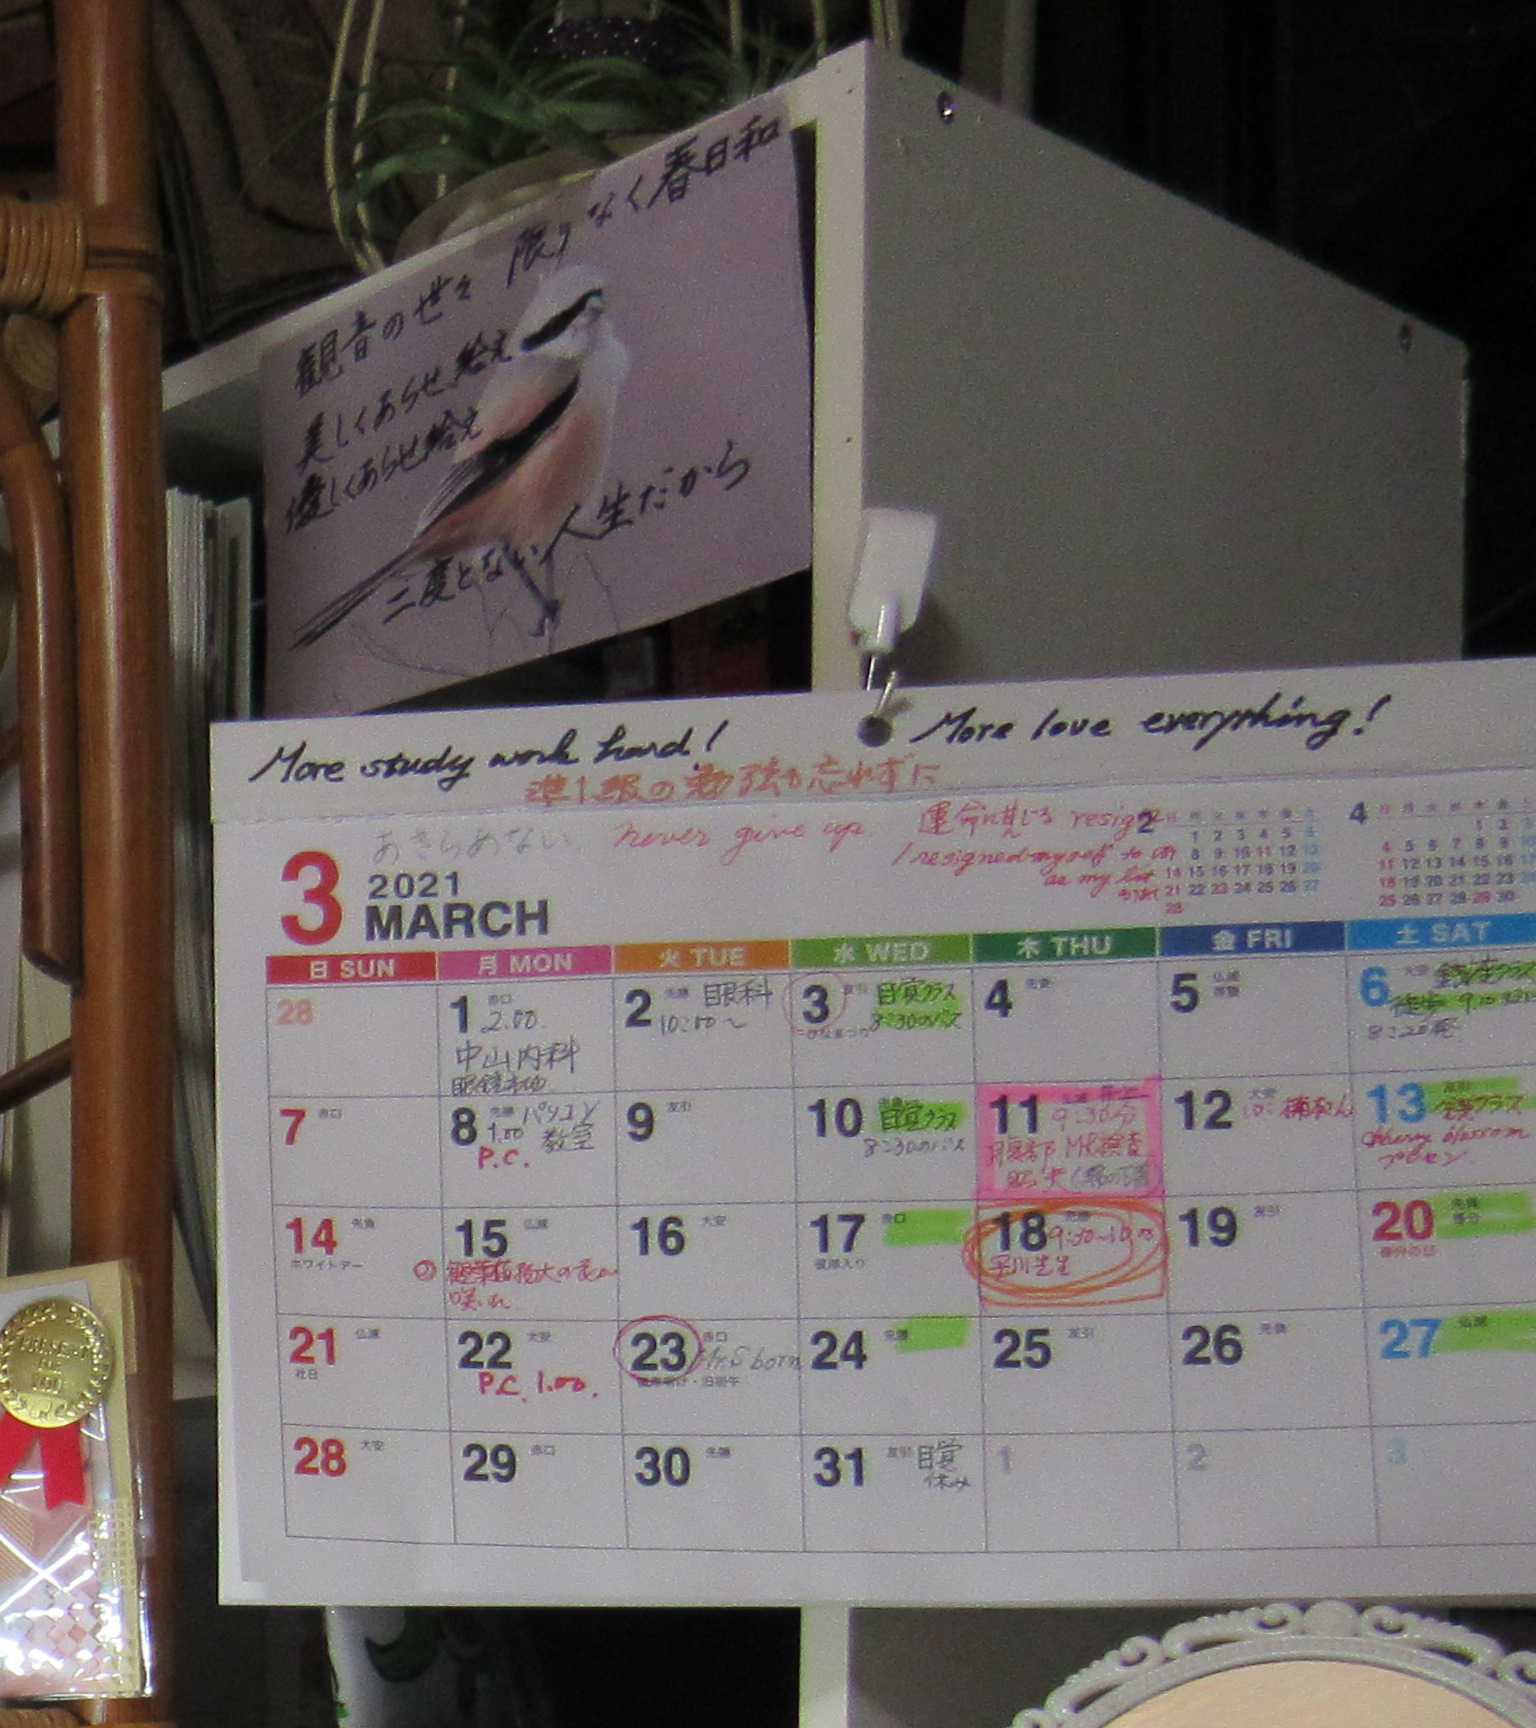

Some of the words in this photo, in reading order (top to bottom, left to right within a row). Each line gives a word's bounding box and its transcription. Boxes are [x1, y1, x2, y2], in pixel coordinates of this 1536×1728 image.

[908, 706, 1015, 745] More
[1029, 708, 1113, 742] love
[248, 740, 346, 784] More
[359, 745, 475, 792] study
[489, 727, 578, 767] work
[1349, 800, 1368, 825] 4
[280, 850, 344, 946] 3
[367, 871, 463, 900] 2021
[364, 899, 551, 943] MARCH
[1245, 927, 1295, 950] FRI
[1430, 920, 1493, 943] SAT
[478, 954, 498, 977] 月
[509, 952, 575, 974] MON
[691, 946, 746, 967] TUE
[868, 942, 930, 964] WED
[1052, 935, 1113, 958] THU
[339, 958, 397, 979] SUN
[1359, 965, 1391, 1009] 6
[625, 988, 653, 1029] 2
[702, 976, 774, 1009] 眼科
[801, 983, 831, 1025] 3
[984, 978, 1014, 1019] 4
[1169, 972, 1201, 1015] 5
[449, 995, 470, 1034] 1
[454, 1033, 582, 1074] 中山内科
[627, 1101, 656, 1143] 9
[807, 1097, 865, 1139] 10
[989, 1093, 1040, 1136] 11
[1173, 1088, 1233, 1131] 12
[1366, 1081, 1426, 1125] 13
[279, 1107, 308, 1147] 7
[449, 1106, 478, 1147] 8
[285, 1215, 338, 1257] 14
[454, 1217, 509, 1259] 15
[630, 1215, 686, 1257] 16
[809, 1213, 866, 1255] 17
[991, 1210, 1049, 1253] 18
[1178, 1205, 1239, 1249] 19
[1370, 1199, 1436, 1243] 20
[288, 1325, 337, 1367] 21
[457, 1330, 513, 1371] 22
[630, 1332, 688, 1374] 23
[810, 1329, 869, 1372] 24
[992, 1327, 1053, 1371] 25
[1180, 1323, 1245, 1367] 26
[1379, 1317, 1443, 1361] 27
[293, 1435, 348, 1478] 28
[461, 1442, 518, 1484] 29
[634, 1445, 692, 1488] 30
[812, 1446, 866, 1488] 31
